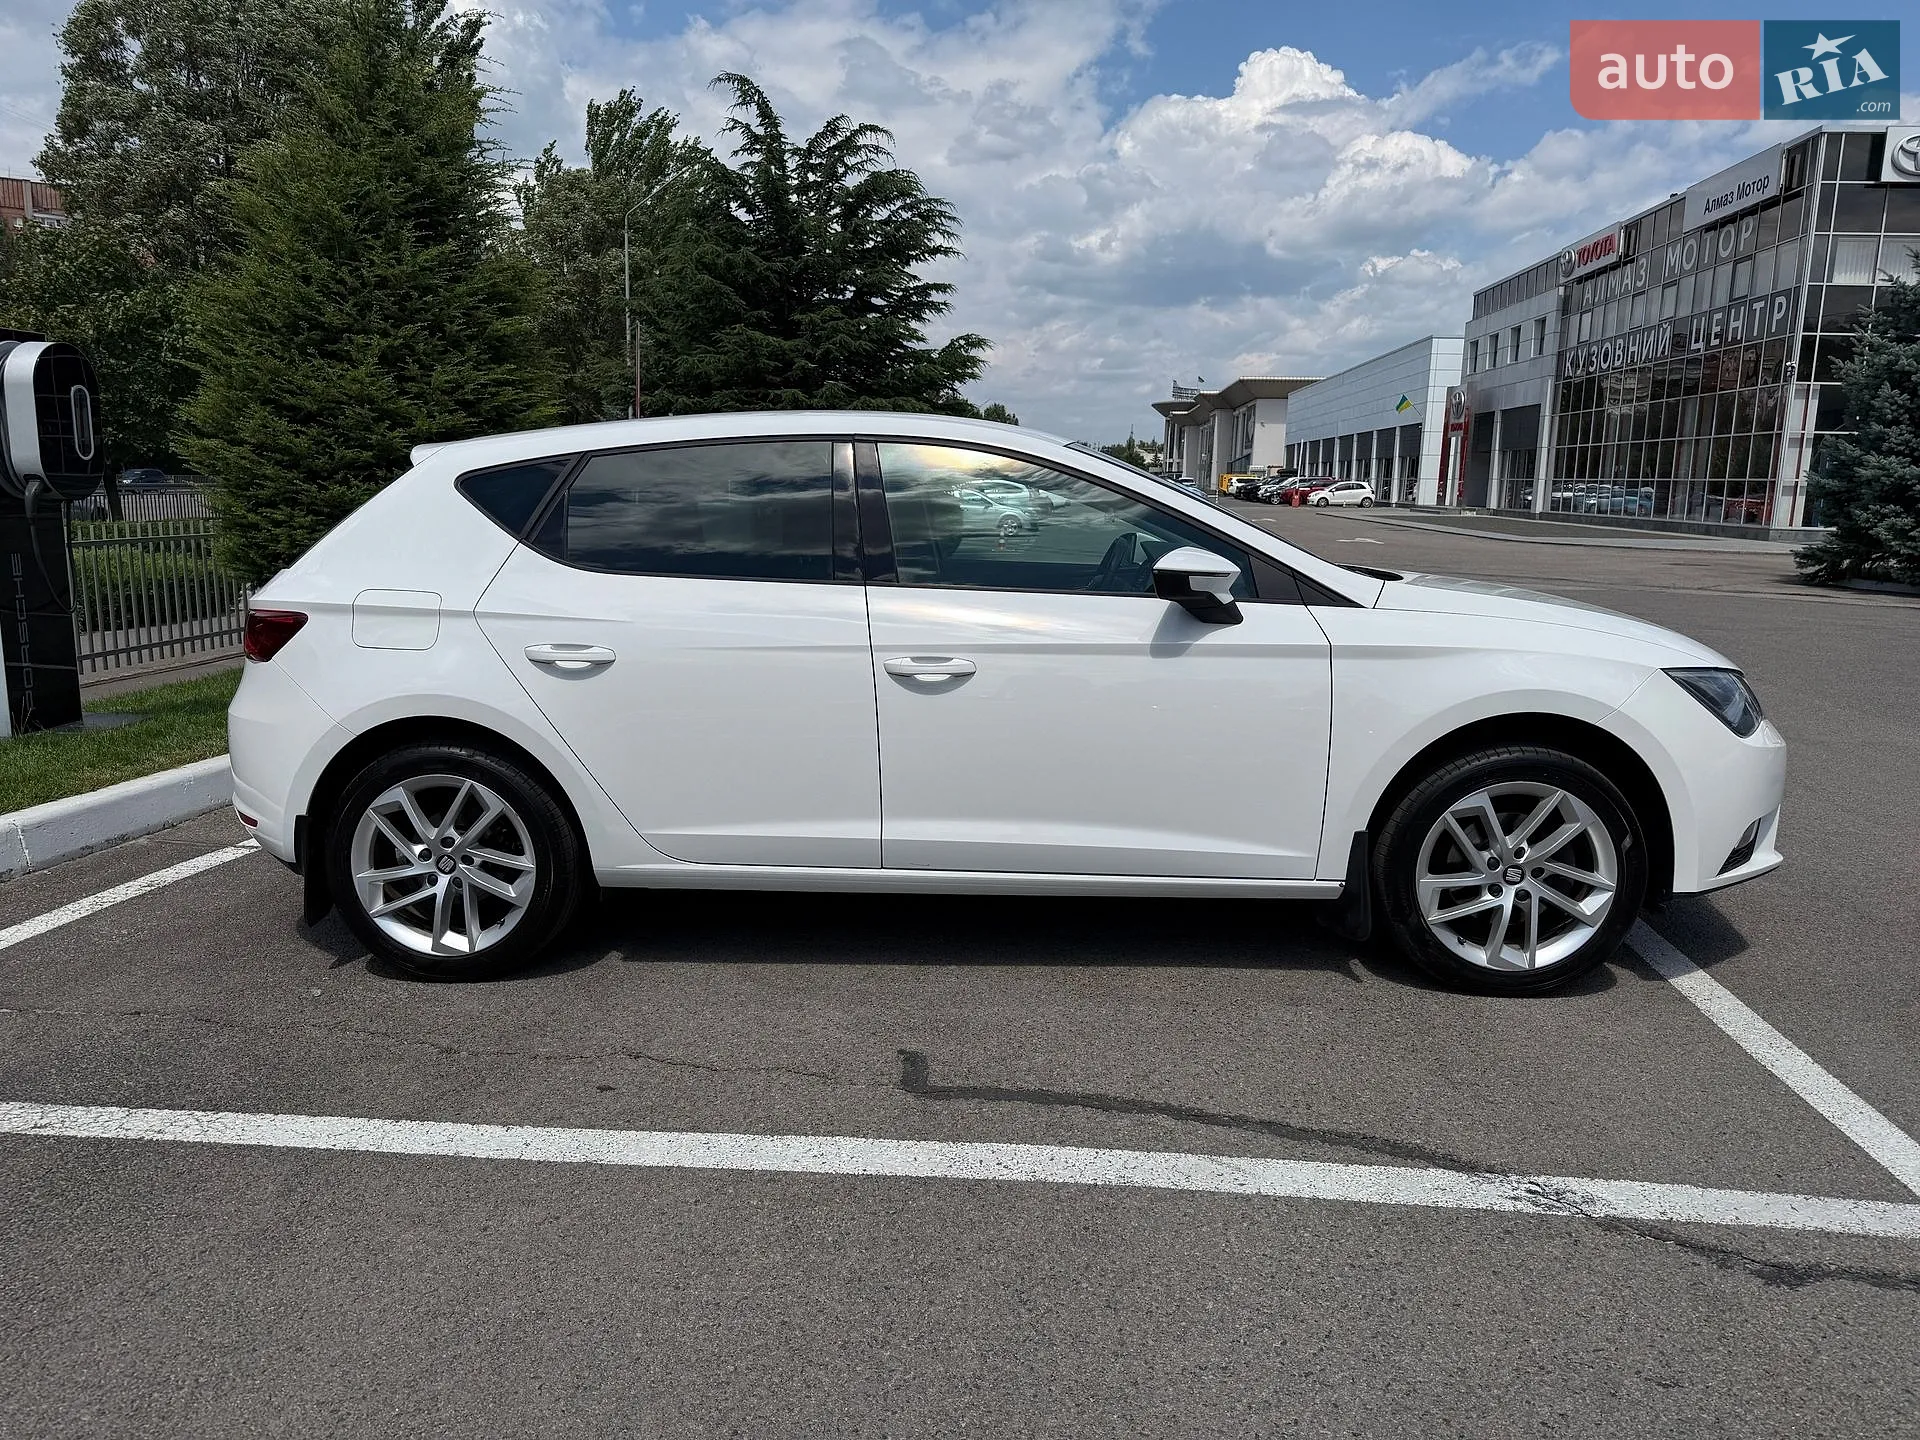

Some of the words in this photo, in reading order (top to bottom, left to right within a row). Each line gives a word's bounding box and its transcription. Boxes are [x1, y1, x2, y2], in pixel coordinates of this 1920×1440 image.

[1703, 190, 1735, 216] Алмаз
[1736, 174, 1770, 201] Мотор
[1576, 233, 1617, 268] TOYOTA
[1582, 257, 1647, 307] АЛМАЗ
[1664, 216, 1754, 278] МОТОР
[1564, 323, 1672, 377] КУЗОВНИЙ
[1690, 295, 1788, 353] ЦЕНТР
[11, 552, 36, 711] PORSCHE
